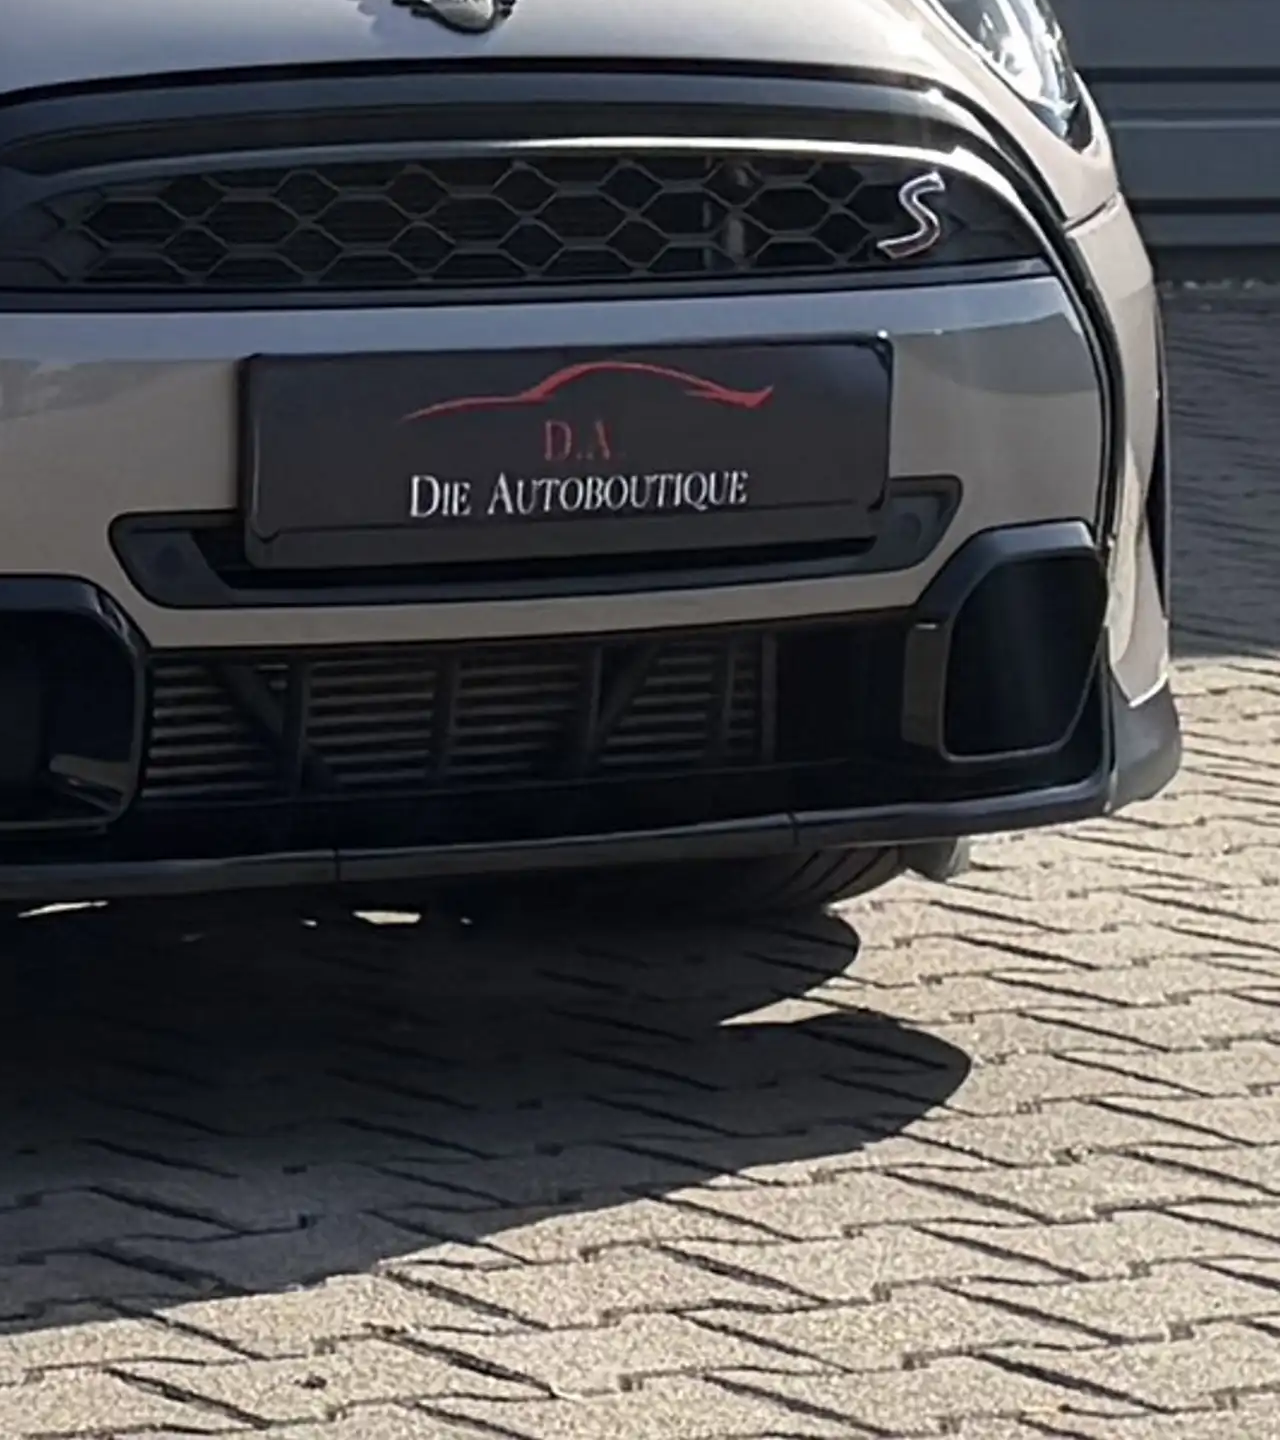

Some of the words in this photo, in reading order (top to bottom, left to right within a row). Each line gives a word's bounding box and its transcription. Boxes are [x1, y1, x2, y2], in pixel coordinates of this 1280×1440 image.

[876, 169, 946, 260] S
[409, 473, 472, 519] DIE
[486, 470, 750, 516] AUTOBOUTIQUE
